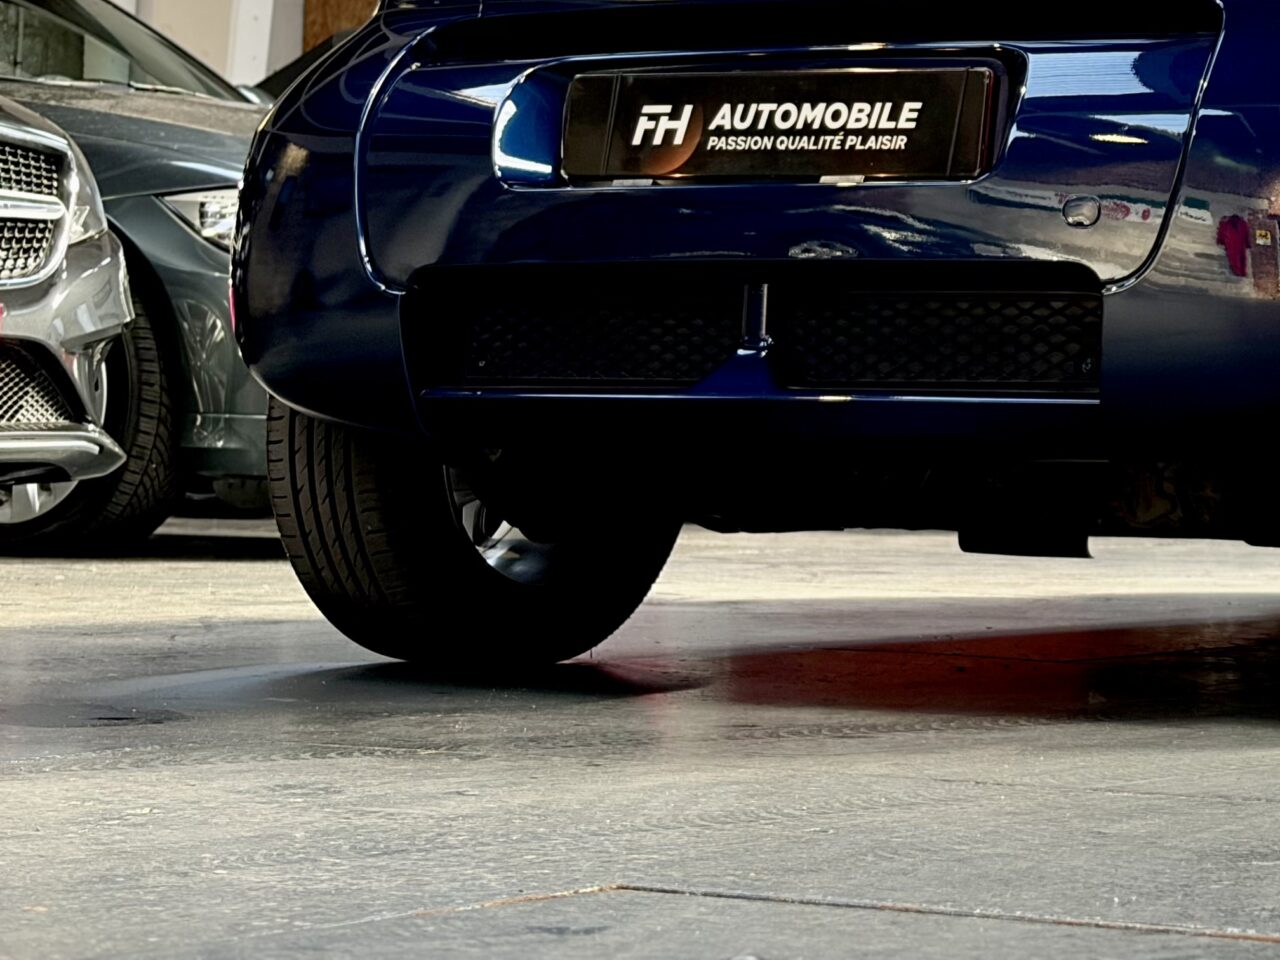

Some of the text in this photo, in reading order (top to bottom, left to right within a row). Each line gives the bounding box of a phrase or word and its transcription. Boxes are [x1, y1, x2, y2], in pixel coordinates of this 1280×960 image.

[631, 104, 694, 146] FH
[708, 101, 923, 131] AUTOMOBILE
[706, 131, 908, 151] PASSION QUALITÉ PLAISIR
